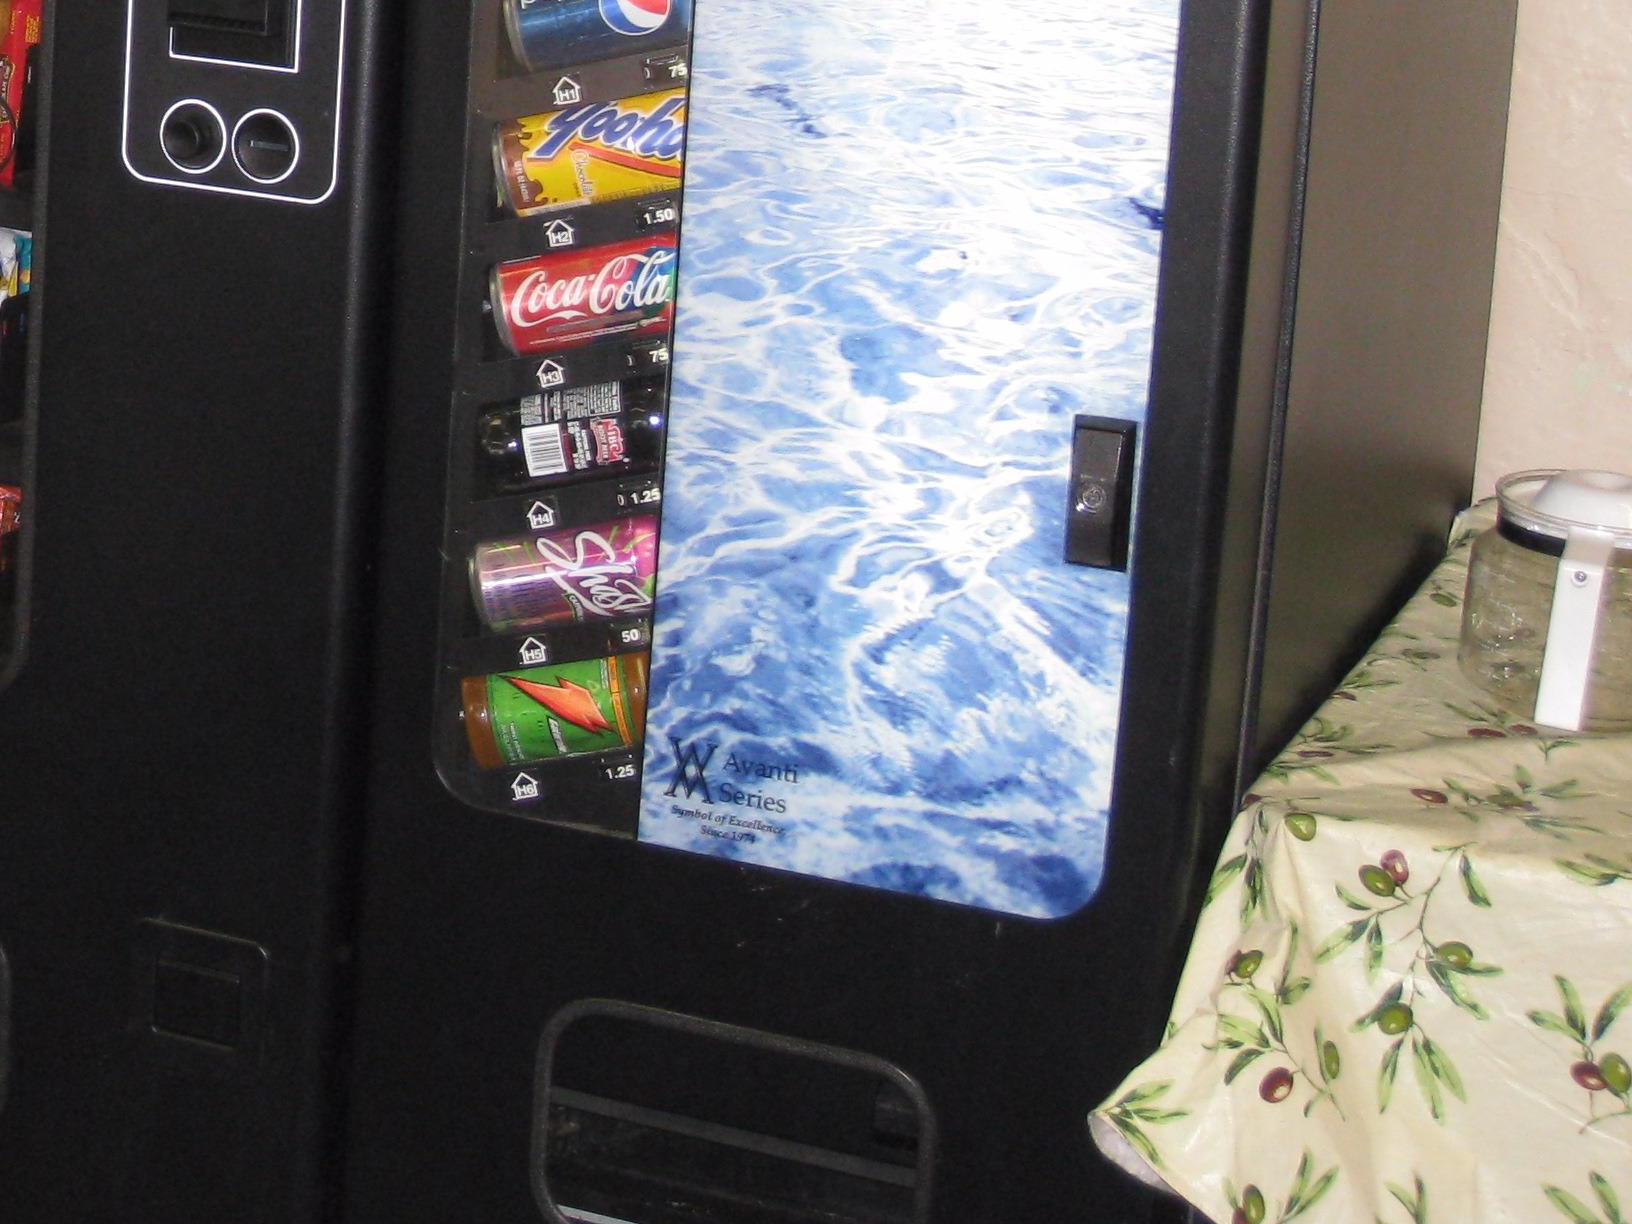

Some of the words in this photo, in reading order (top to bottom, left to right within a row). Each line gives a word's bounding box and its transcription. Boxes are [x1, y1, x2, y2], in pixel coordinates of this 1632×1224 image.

[668, 64, 687, 79] 75
[558, 88, 576, 101] H1
[643, 207, 674, 226] 1.50
[551, 230, 570, 244] H2
[510, 249, 674, 328] Coca-Cola
[649, 347, 669, 363] 75
[542, 370, 560, 383] H3
[630, 487, 661, 505] 1.25
[532, 512, 551, 526] H4
[621, 628, 640, 644] 50
[524, 649, 543, 662] H5
[605, 763, 635, 780] 1.25
[722, 752, 799, 784] Avanti
[515, 783, 535, 797] H6
[719, 782, 787, 814] Series
[672, 804, 712, 820] Symbol
[714, 812, 727, 825] of
[728, 815, 785, 835] Excellence
[700, 824, 729, 839] Since
